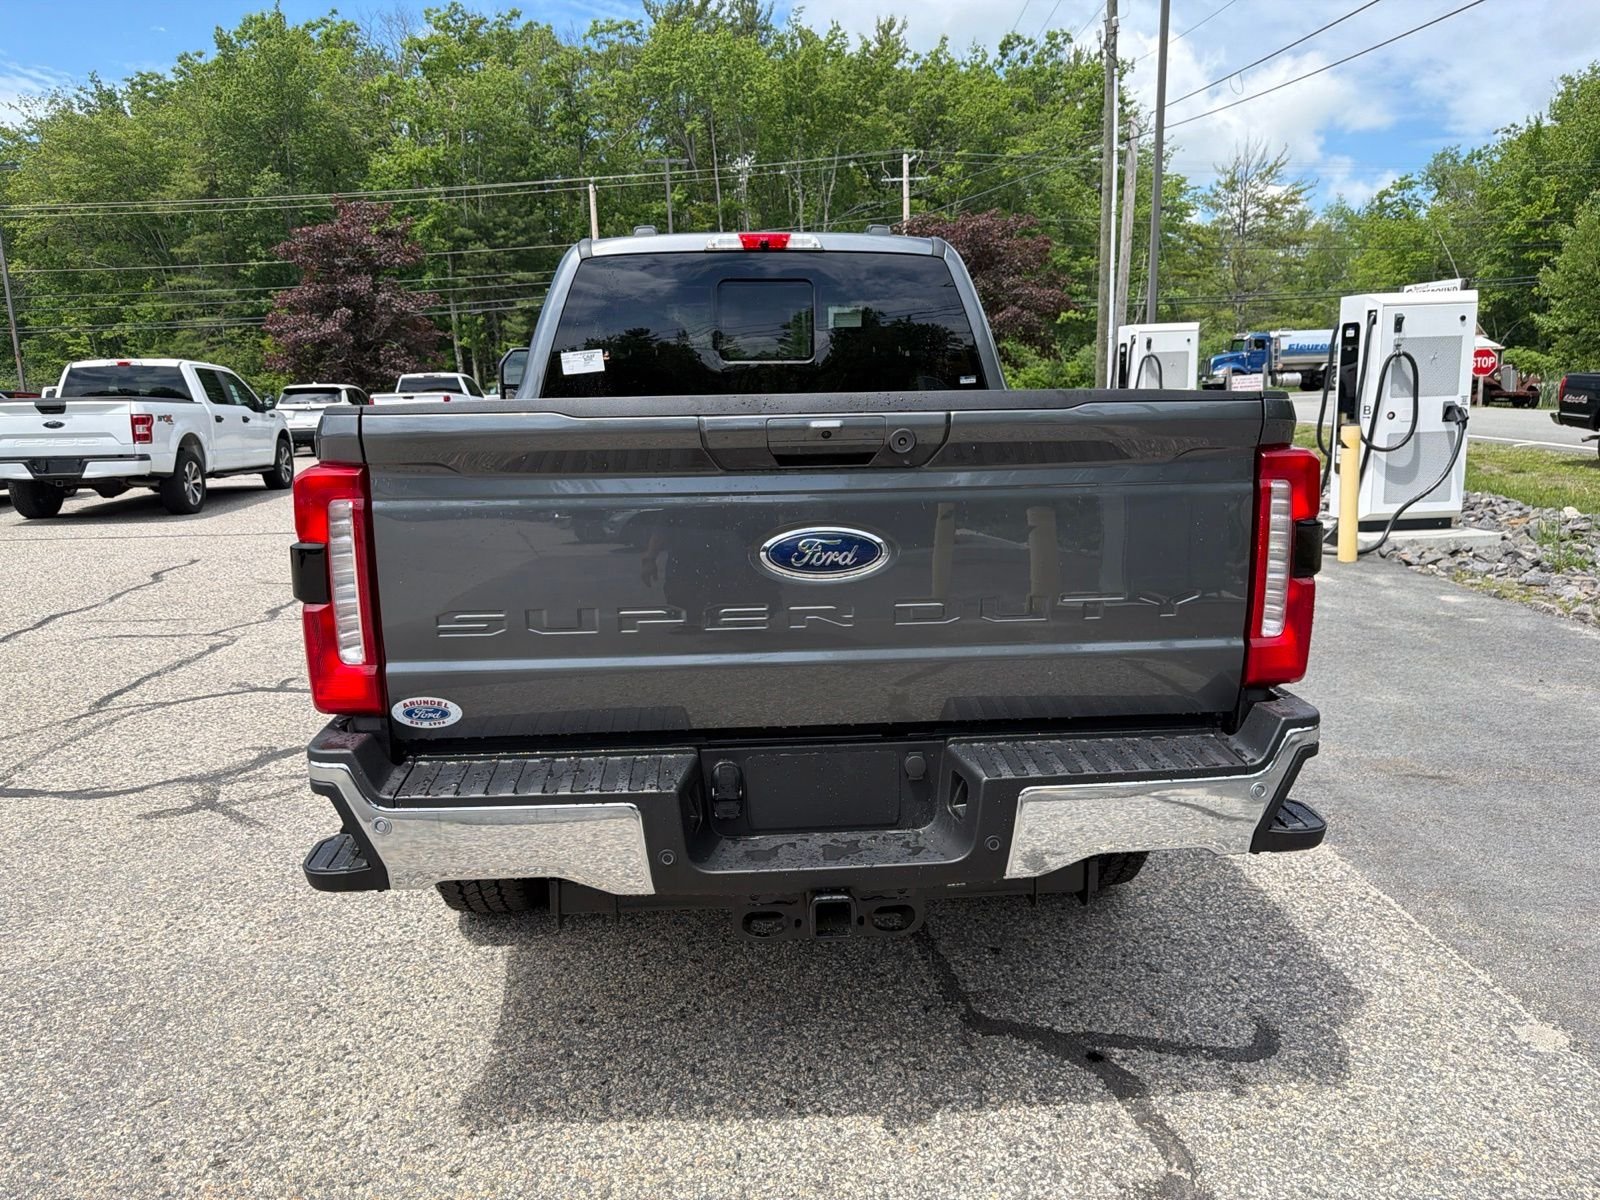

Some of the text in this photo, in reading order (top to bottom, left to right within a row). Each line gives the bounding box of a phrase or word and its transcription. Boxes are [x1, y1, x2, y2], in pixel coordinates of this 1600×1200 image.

[1472, 357, 1496, 368] STOP
[1363, 404, 1371, 415] B
[791, 538, 859, 567] Ford
[435, 588, 1201, 638] SUPER DUTY
[403, 700, 449, 709] ARUNDEL
[412, 708, 442, 719] Ford
